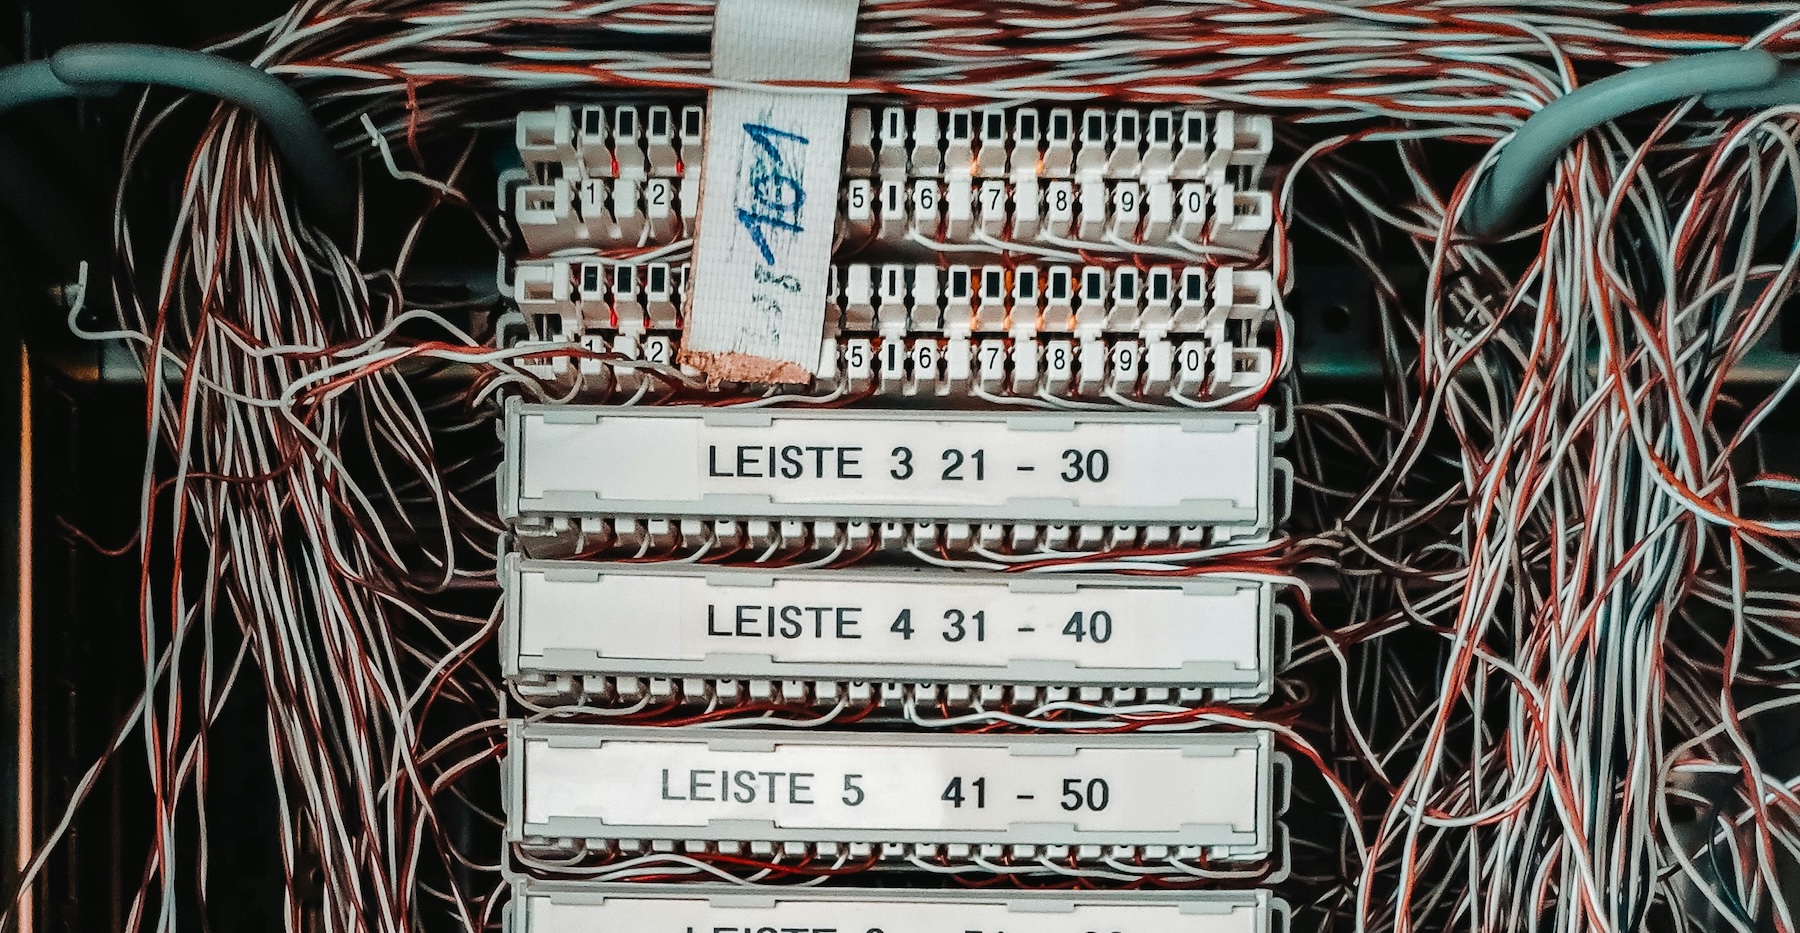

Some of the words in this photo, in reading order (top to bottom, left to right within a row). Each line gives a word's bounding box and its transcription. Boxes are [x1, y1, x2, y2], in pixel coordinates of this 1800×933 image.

[587, 184, 596, 205] 1
[652, 184, 665, 205] 2
[852, 187, 864, 209] 5
[920, 188, 933, 210] 6
[988, 189, 1001, 211] 7
[1056, 190, 1067, 212] 8
[1121, 191, 1134, 212] 9
[1189, 191, 1201, 213] 0
[585, 339, 594, 362] 1
[651, 341, 663, 363] 2
[851, 345, 863, 368] 5
[919, 346, 932, 369] 6
[987, 347, 999, 370] 7
[1054, 348, 1066, 371] 8
[1119, 350, 1132, 371] 9
[1187, 349, 1199, 372] 0
[708, 445, 863, 479] LEISTE
[890, 446, 914, 481] 3
[941, 448, 984, 481] 21
[1060, 449, 1109, 483] 30
[707, 604, 862, 639] LEISTE
[890, 608, 915, 641] 4
[942, 608, 985, 643] 31
[1062, 610, 1112, 644] 40
[661, 768, 815, 805] LEISTE
[841, 774, 865, 807] 5
[941, 776, 986, 809] 41
[1060, 778, 1109, 812] 50
